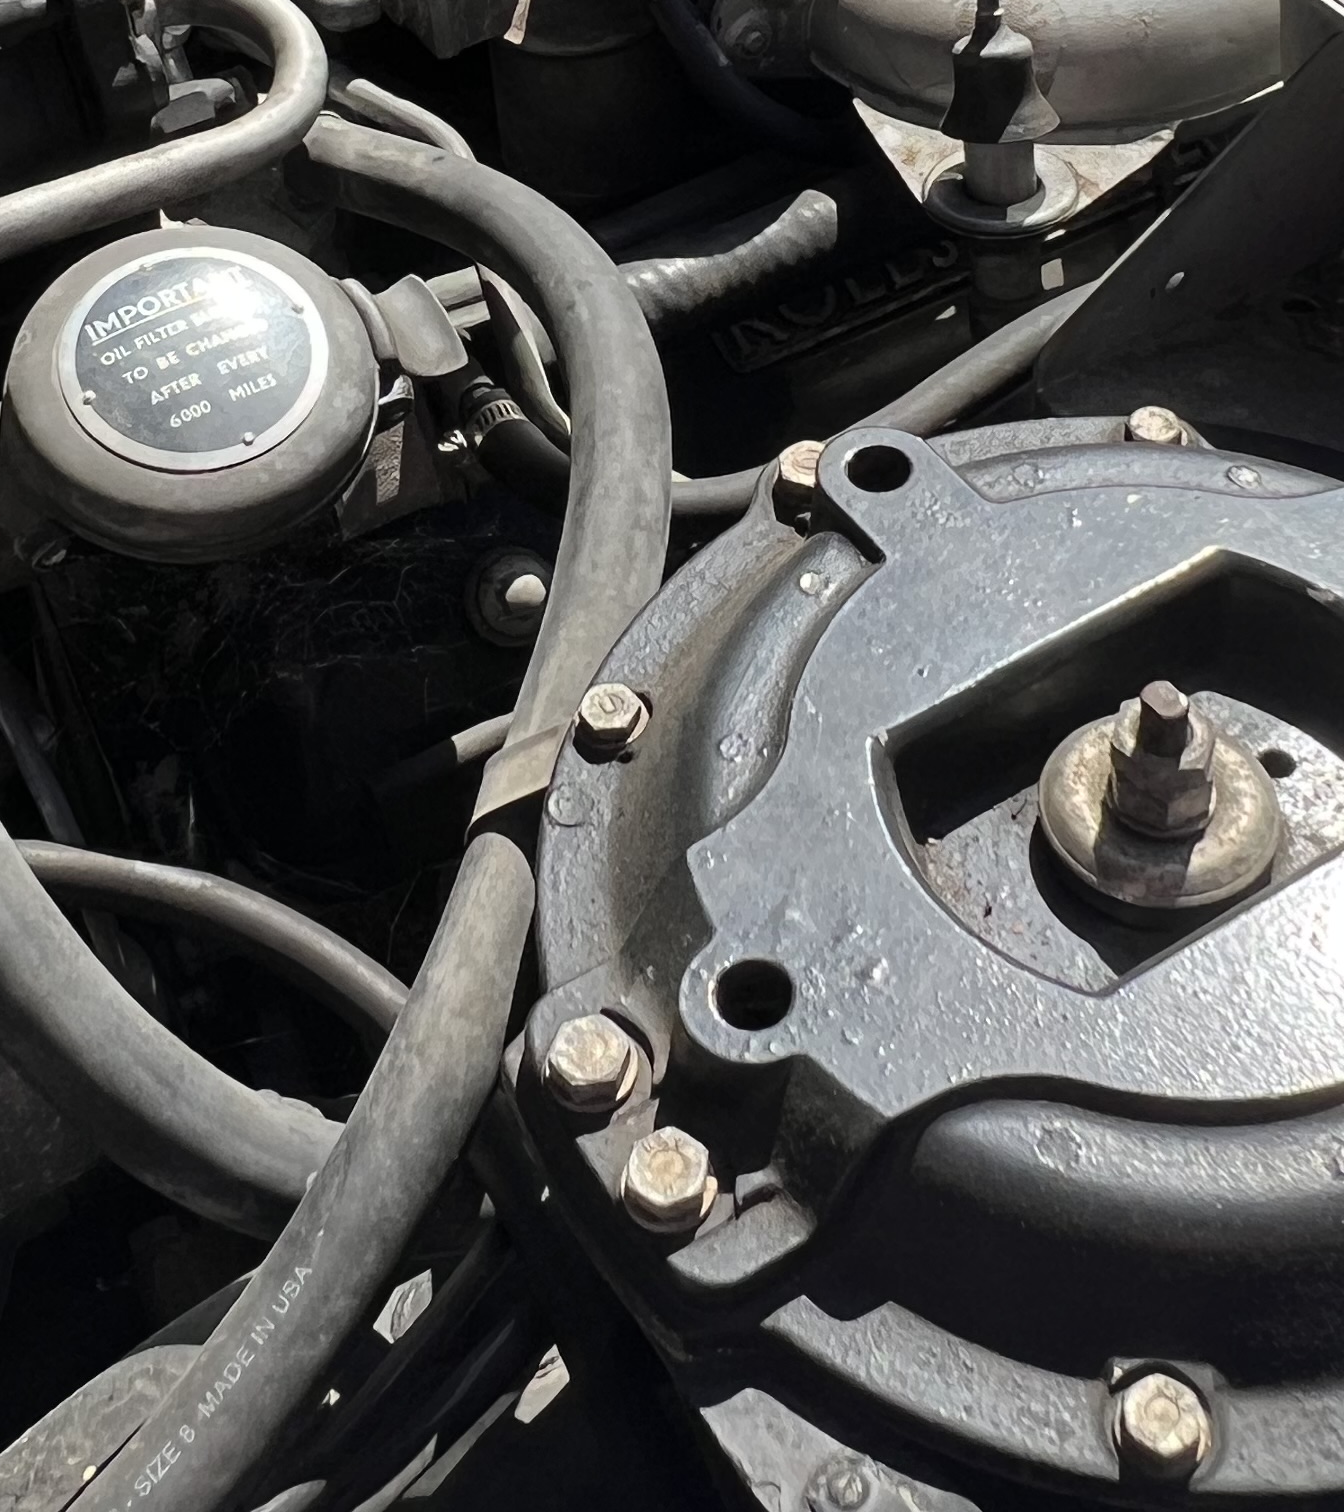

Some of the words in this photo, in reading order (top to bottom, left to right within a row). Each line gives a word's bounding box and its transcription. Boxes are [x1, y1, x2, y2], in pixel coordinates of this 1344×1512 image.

[100, 345, 132, 366] OIL
[133, 319, 189, 350] FILTER
[122, 366, 149, 384] TO
[156, 350, 181, 370] BE
[185, 317, 269, 357] CHAND
[151, 372, 203, 406] AFTER
[216, 344, 270, 375] EVERY
[169, 399, 212, 428] 6000
[228, 373, 277, 402] MILES
[134, 1441, 182, 1497] SIZE
[179, 1424, 196, 1443] 8
[198, 1345, 256, 1418] MADE
[250, 1316, 275, 1345] IN
[272, 1266, 313, 1315] USA
